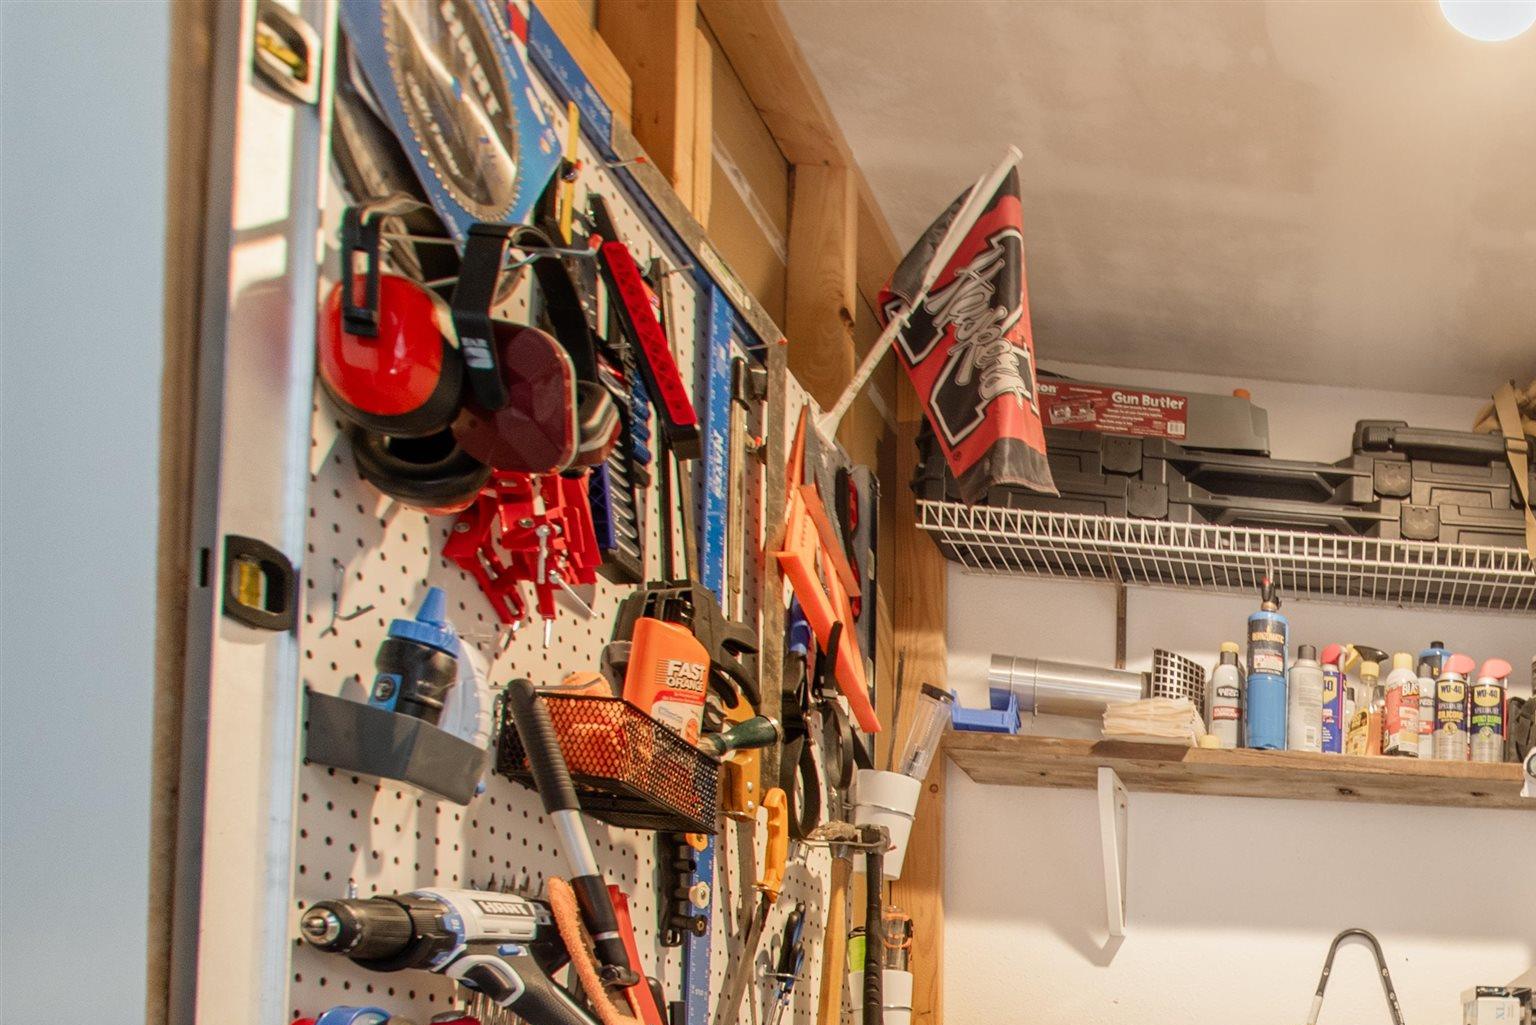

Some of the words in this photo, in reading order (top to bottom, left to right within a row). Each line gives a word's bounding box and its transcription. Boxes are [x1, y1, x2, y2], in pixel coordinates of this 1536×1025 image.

[1112, 391, 1139, 406] Gun
[1142, 394, 1184, 410] Butler
[667, 660, 705, 681] FAST
[666, 676, 704, 692] ORANGE
[1440, 684, 1463, 694] WD-40
[1476, 689, 1498, 699] WD-40
[478, 901, 530, 916] HART
